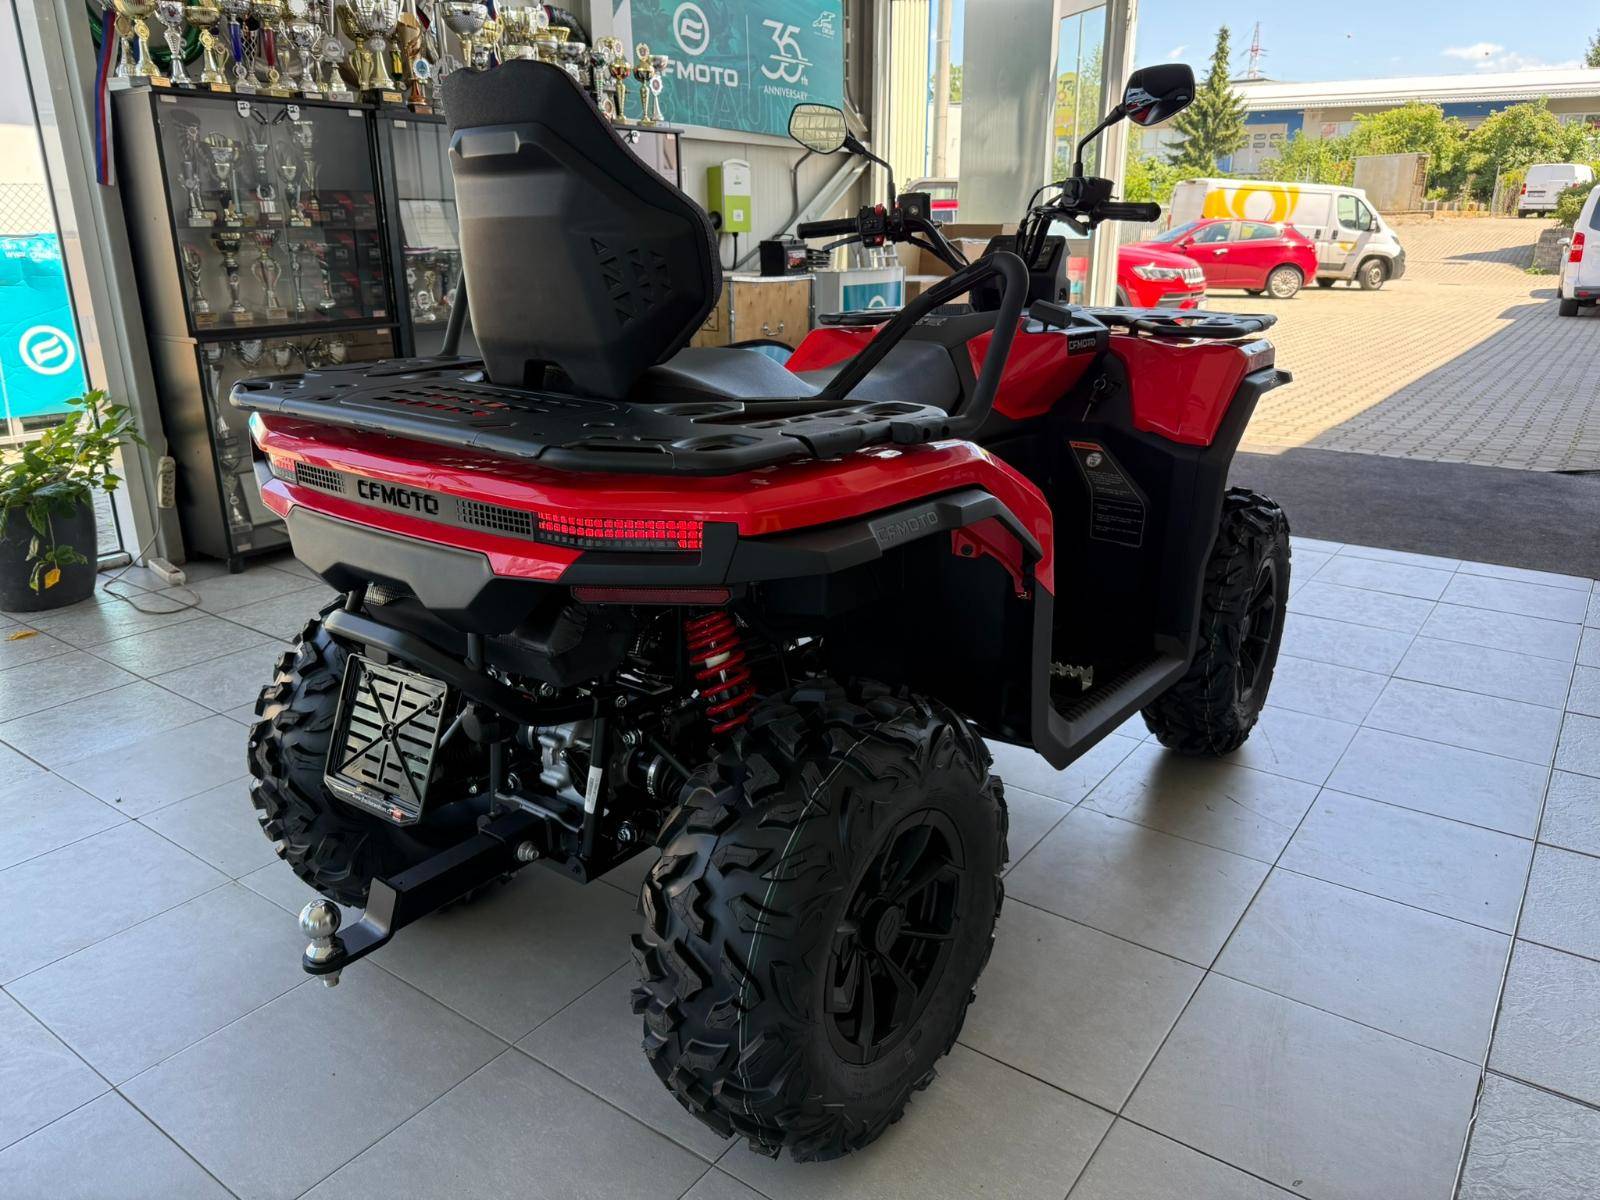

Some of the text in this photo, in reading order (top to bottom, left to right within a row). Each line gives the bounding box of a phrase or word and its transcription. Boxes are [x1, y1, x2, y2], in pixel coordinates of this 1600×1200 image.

[656, 58, 739, 88] FMOTO
[763, 84, 809, 101] ANNIVERSARY
[1068, 337, 1096, 350] CFMOTO
[357, 479, 439, 515] CFMOTO
[877, 511, 939, 544] CFMOTO
